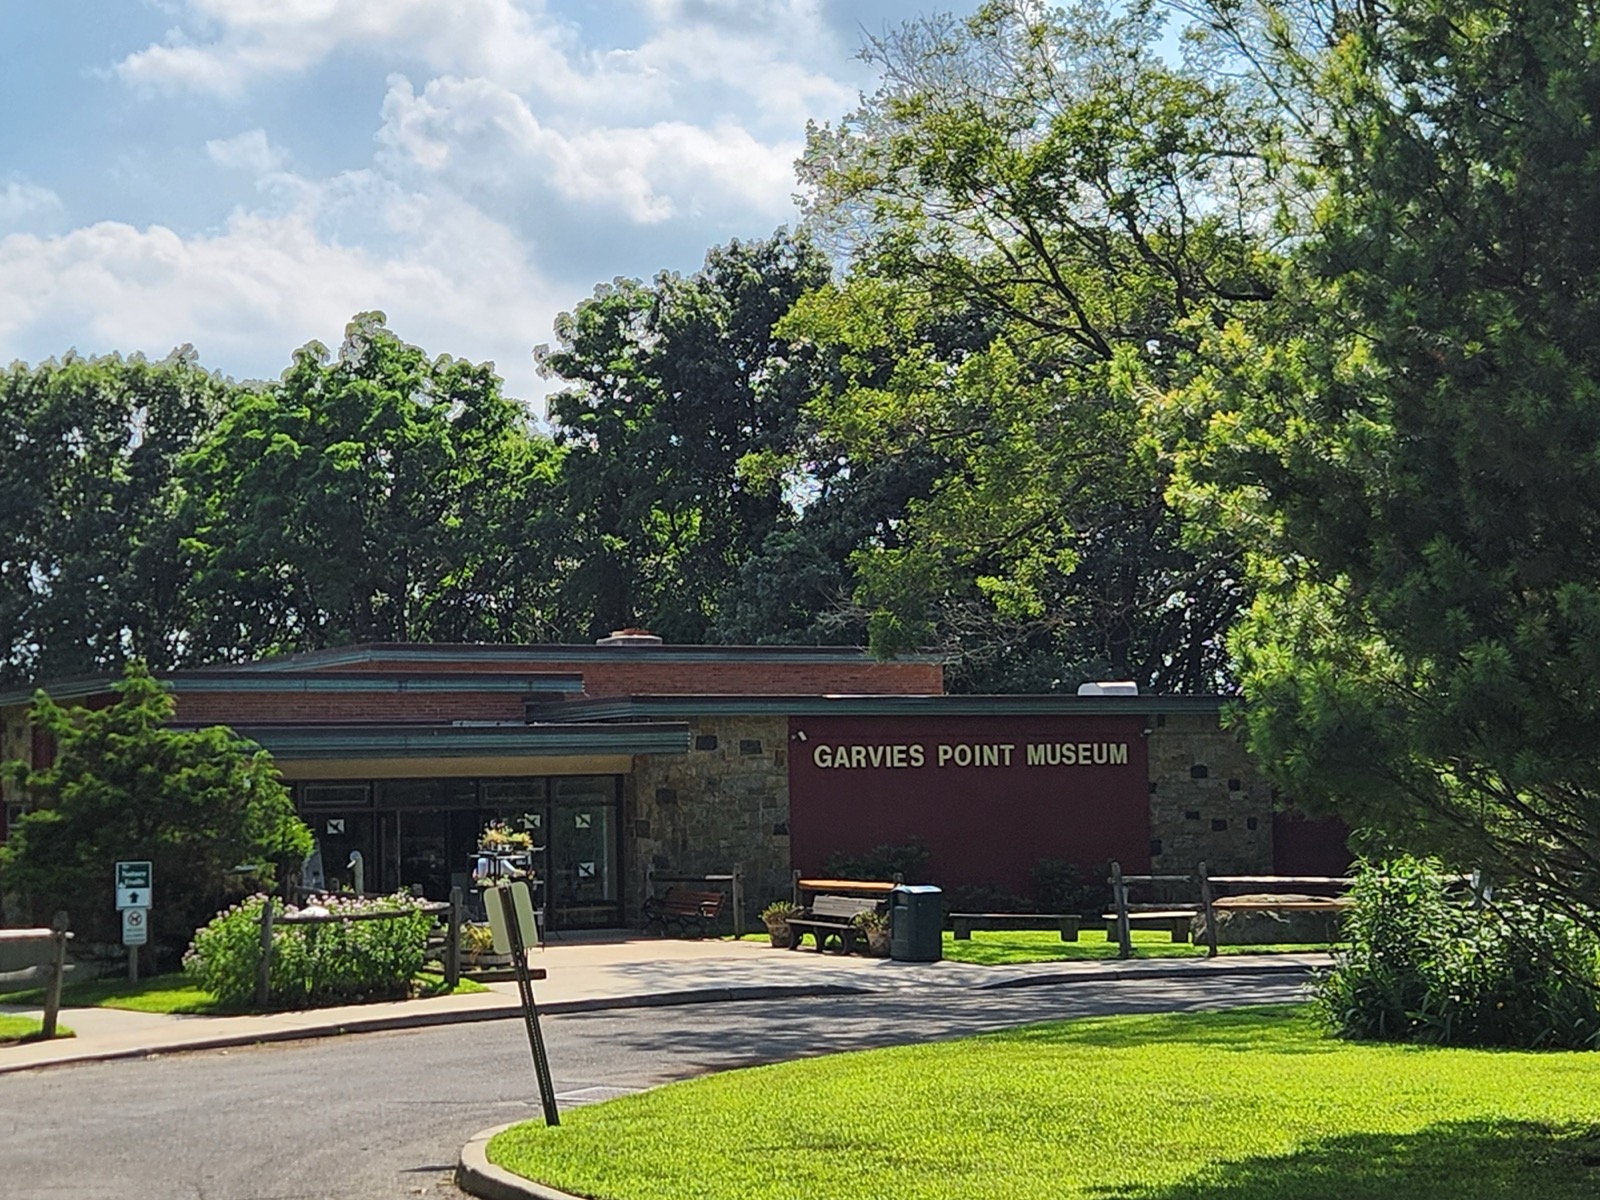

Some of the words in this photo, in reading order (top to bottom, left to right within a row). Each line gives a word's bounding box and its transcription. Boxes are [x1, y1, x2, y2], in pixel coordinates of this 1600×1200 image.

[813, 744, 925, 768] GARVIES
[938, 744, 1015, 767] POINT
[1027, 743, 1128, 766] MUSEUM
